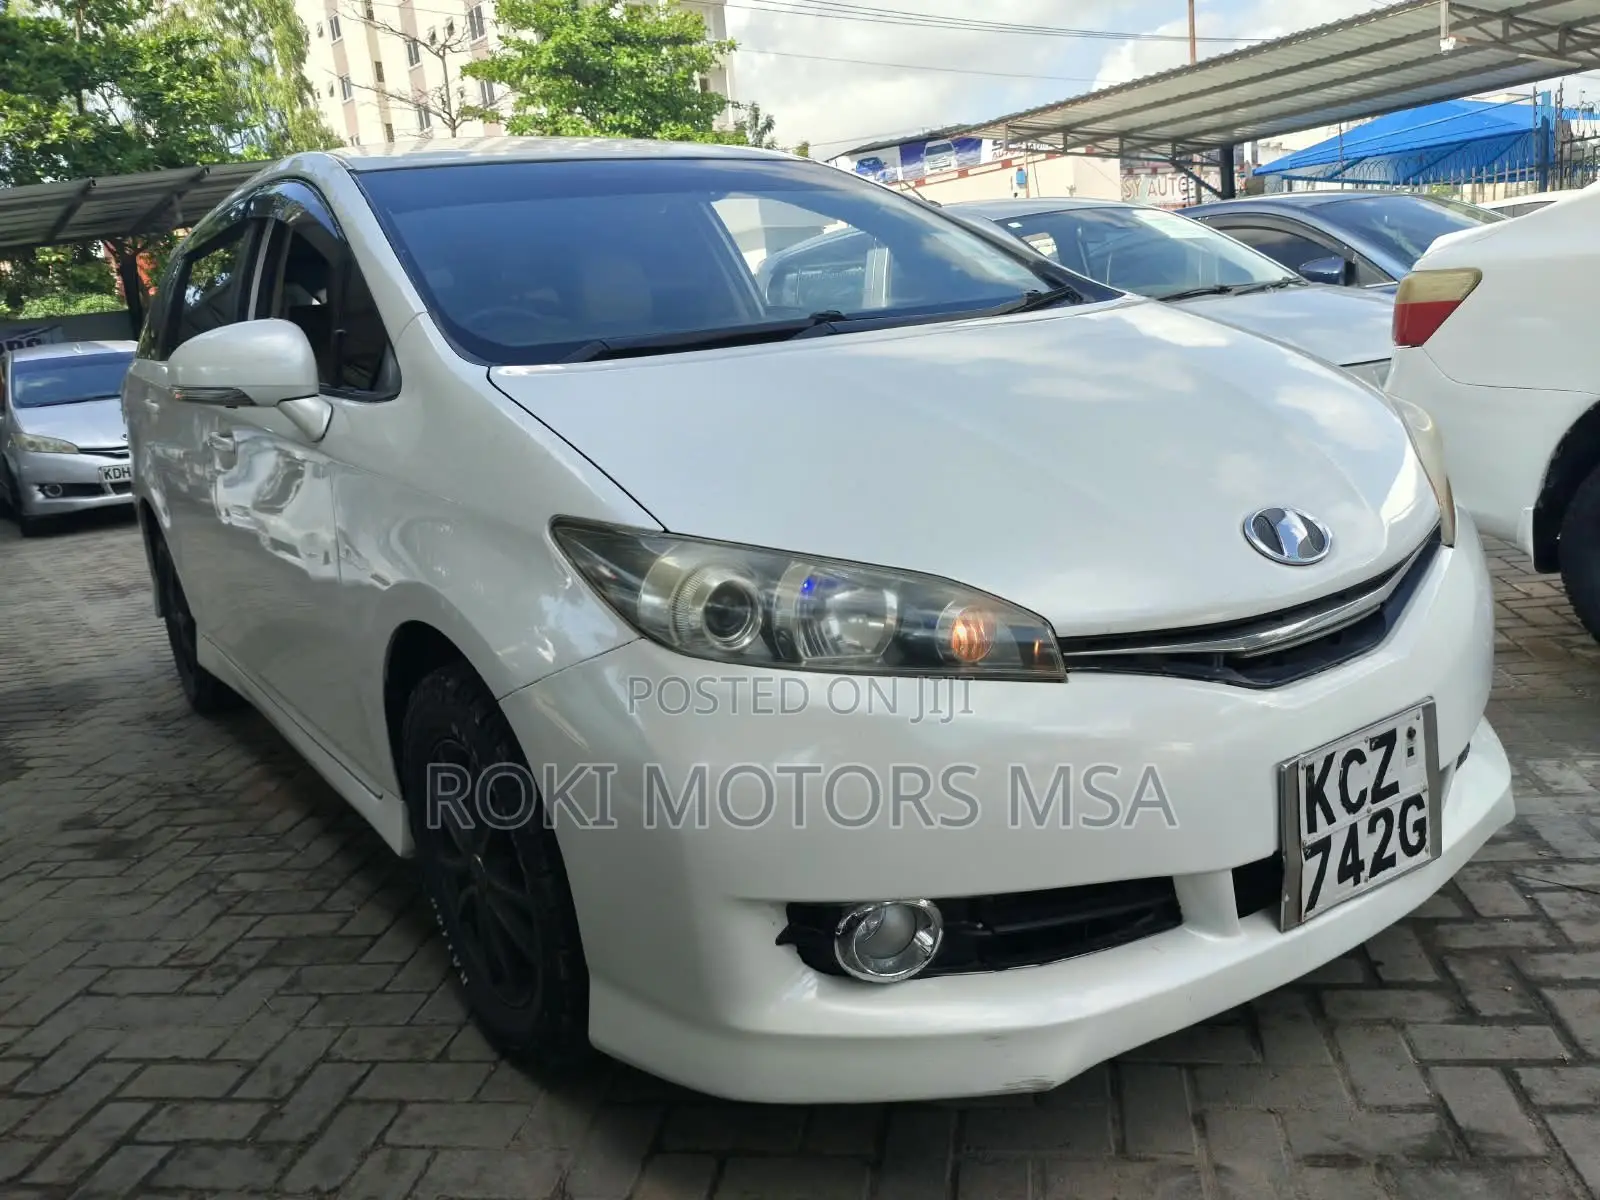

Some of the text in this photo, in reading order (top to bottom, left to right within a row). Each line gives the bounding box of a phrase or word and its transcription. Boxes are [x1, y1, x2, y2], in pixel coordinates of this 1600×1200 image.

[1121, 176, 1142, 198] SY
[104, 466, 132, 480] KDH
[1305, 728, 1400, 834] KCZ
[1304, 793, 1428, 914] 742G
